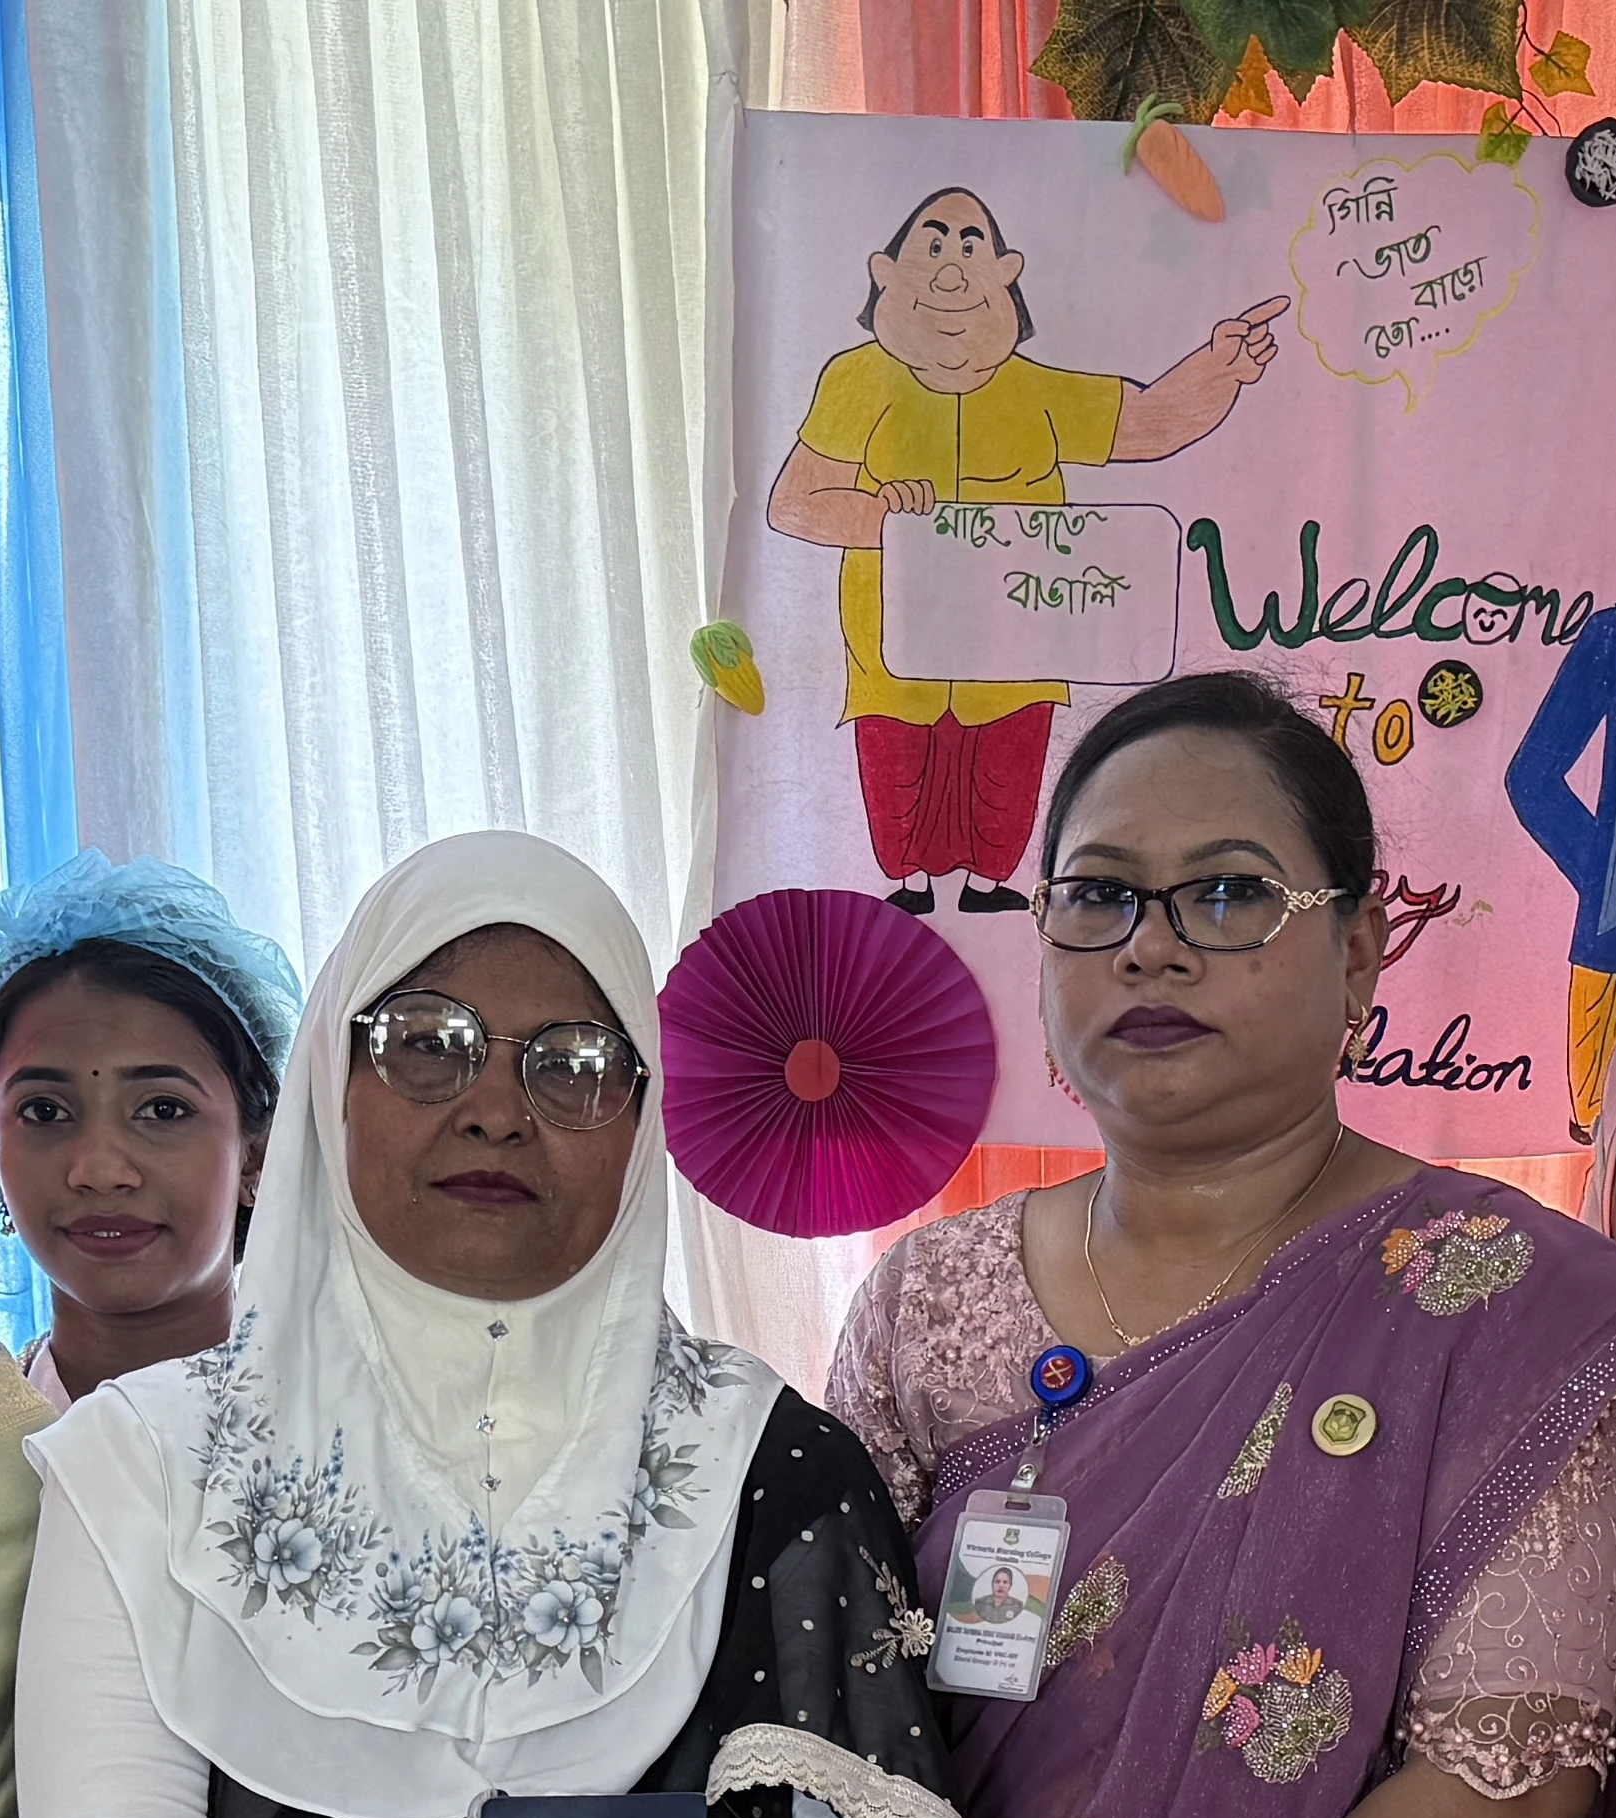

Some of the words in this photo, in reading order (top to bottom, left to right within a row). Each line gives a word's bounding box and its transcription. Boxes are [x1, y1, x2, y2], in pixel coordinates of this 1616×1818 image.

[1323, 176, 1398, 235] গিন্নি
[1337, 225, 1442, 279] ভাত
[1410, 256, 1488, 309] বাড়ো
[934, 505, 1011, 548] মাছে
[1015, 510, 1108, 555] ভাতে
[1186, 517, 1594, 651] Welcome
[1318, 672, 1414, 767] to
